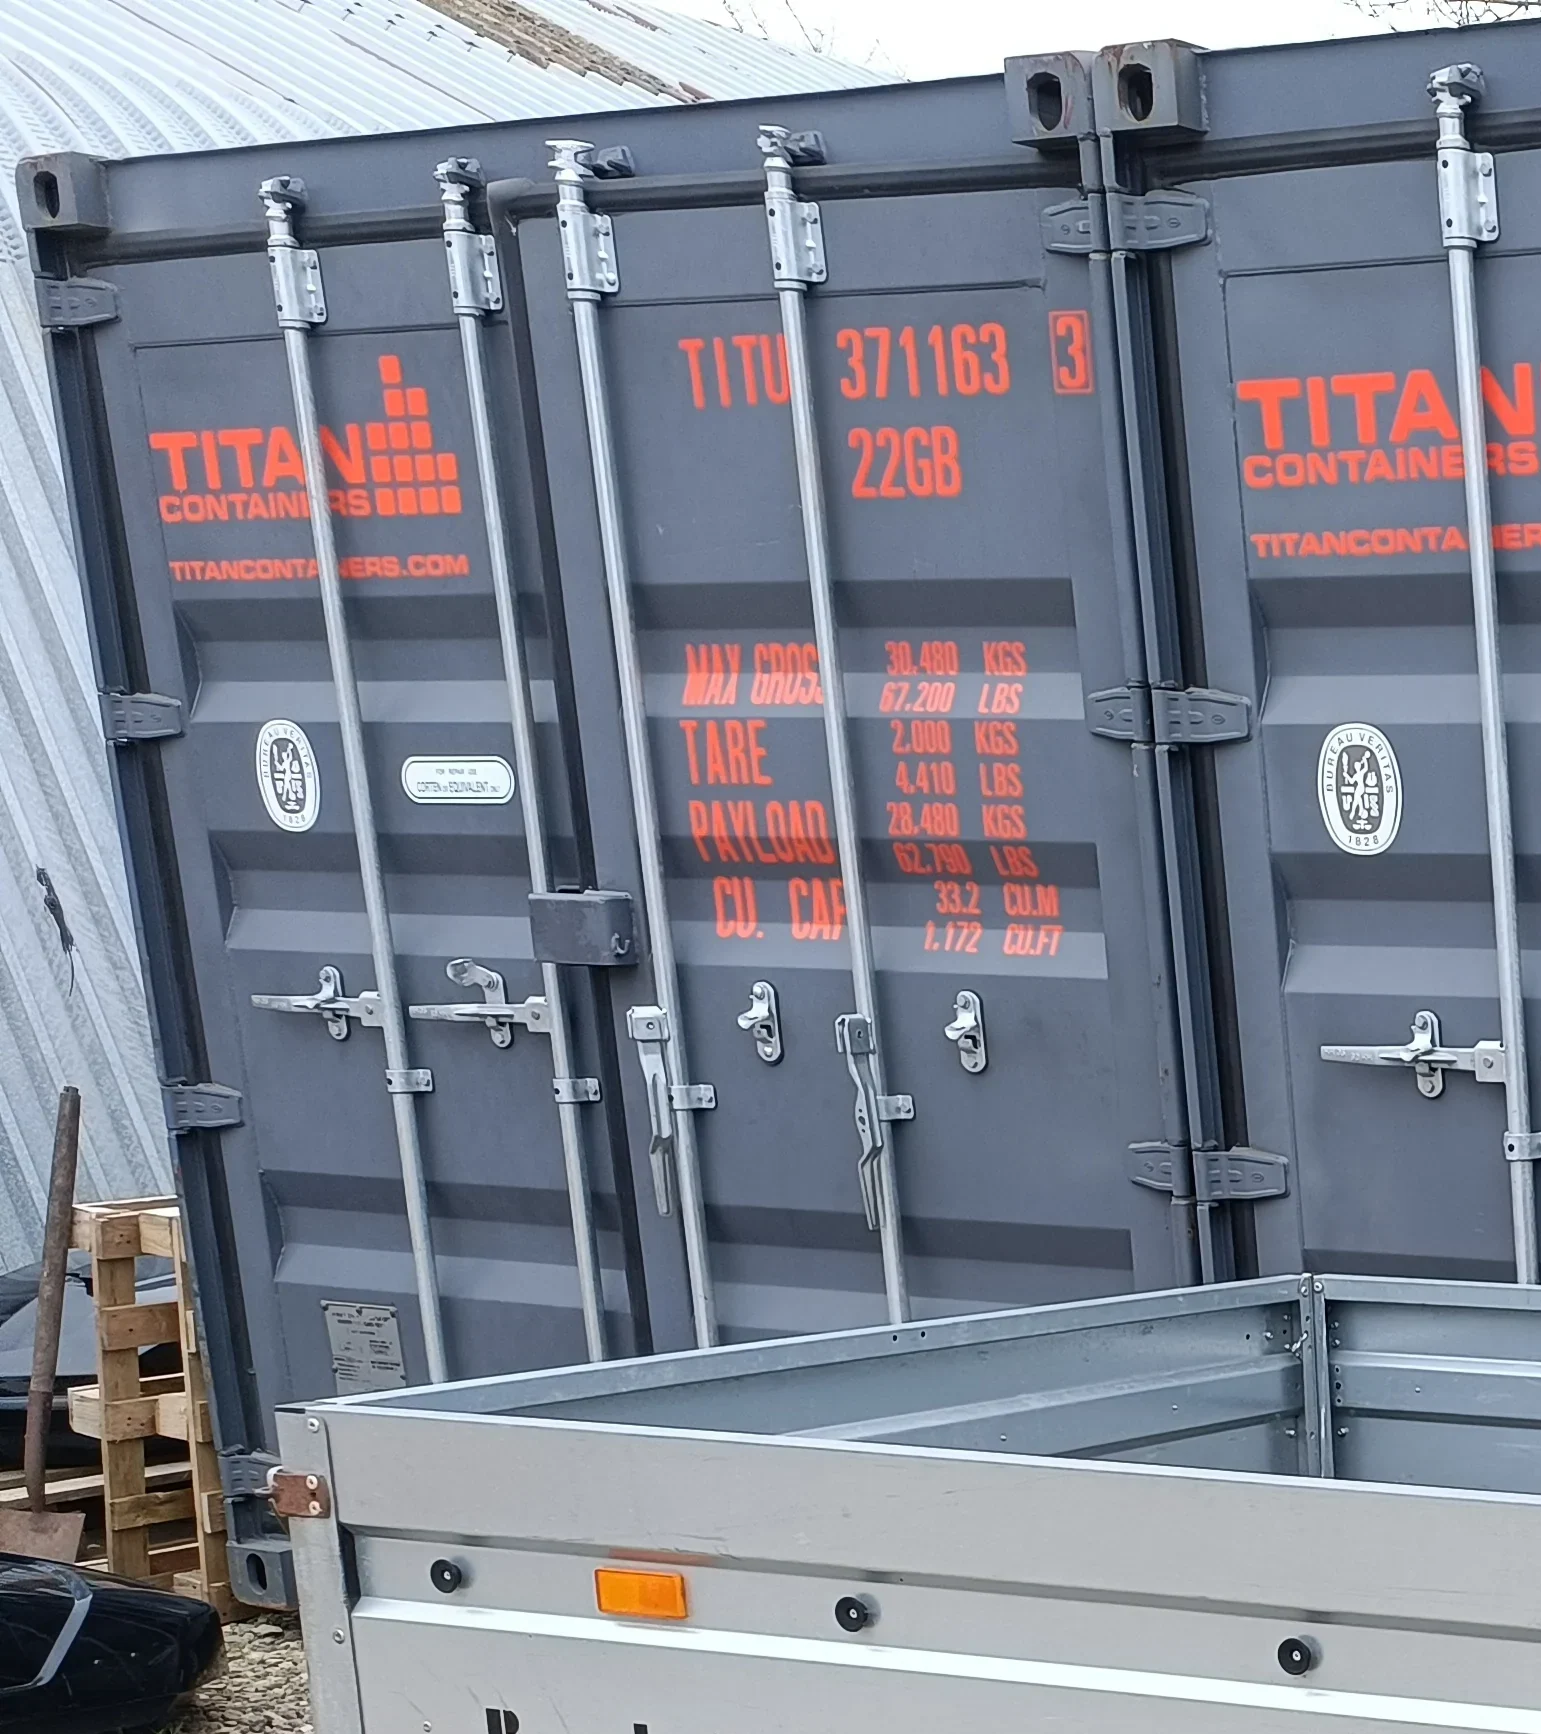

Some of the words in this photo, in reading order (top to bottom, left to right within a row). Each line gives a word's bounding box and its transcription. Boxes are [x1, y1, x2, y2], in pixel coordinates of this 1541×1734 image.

[679, 332, 793, 410] TITU
[837, 322, 1011, 400] 371163
[1055, 315, 1089, 389] 3
[1237, 362, 1535, 450] TITAN
[149, 424, 367, 491] TITAN
[849, 425, 962, 500] 22GB
[168, 554, 471, 582] TITANCONTAERS.COM
[683, 644, 742, 707] MAX
[983, 642, 1028, 678] KGS
[978, 683, 1024, 716] LBS
[680, 719, 774, 787] TARE
[974, 721, 1020, 757] KGS
[980, 763, 1025, 799] LBS
[689, 800, 837, 866] PAYLOAD
[981, 805, 1028, 841] KGS
[990, 845, 1041, 880] LBS
[1348, 834, 1380, 847] 1828
[713, 876, 764, 940] CU.
[934, 880, 982, 917] 33.2
[1003, 882, 1060, 919] CU.M
[1003, 923, 1064, 957] CU.FT
